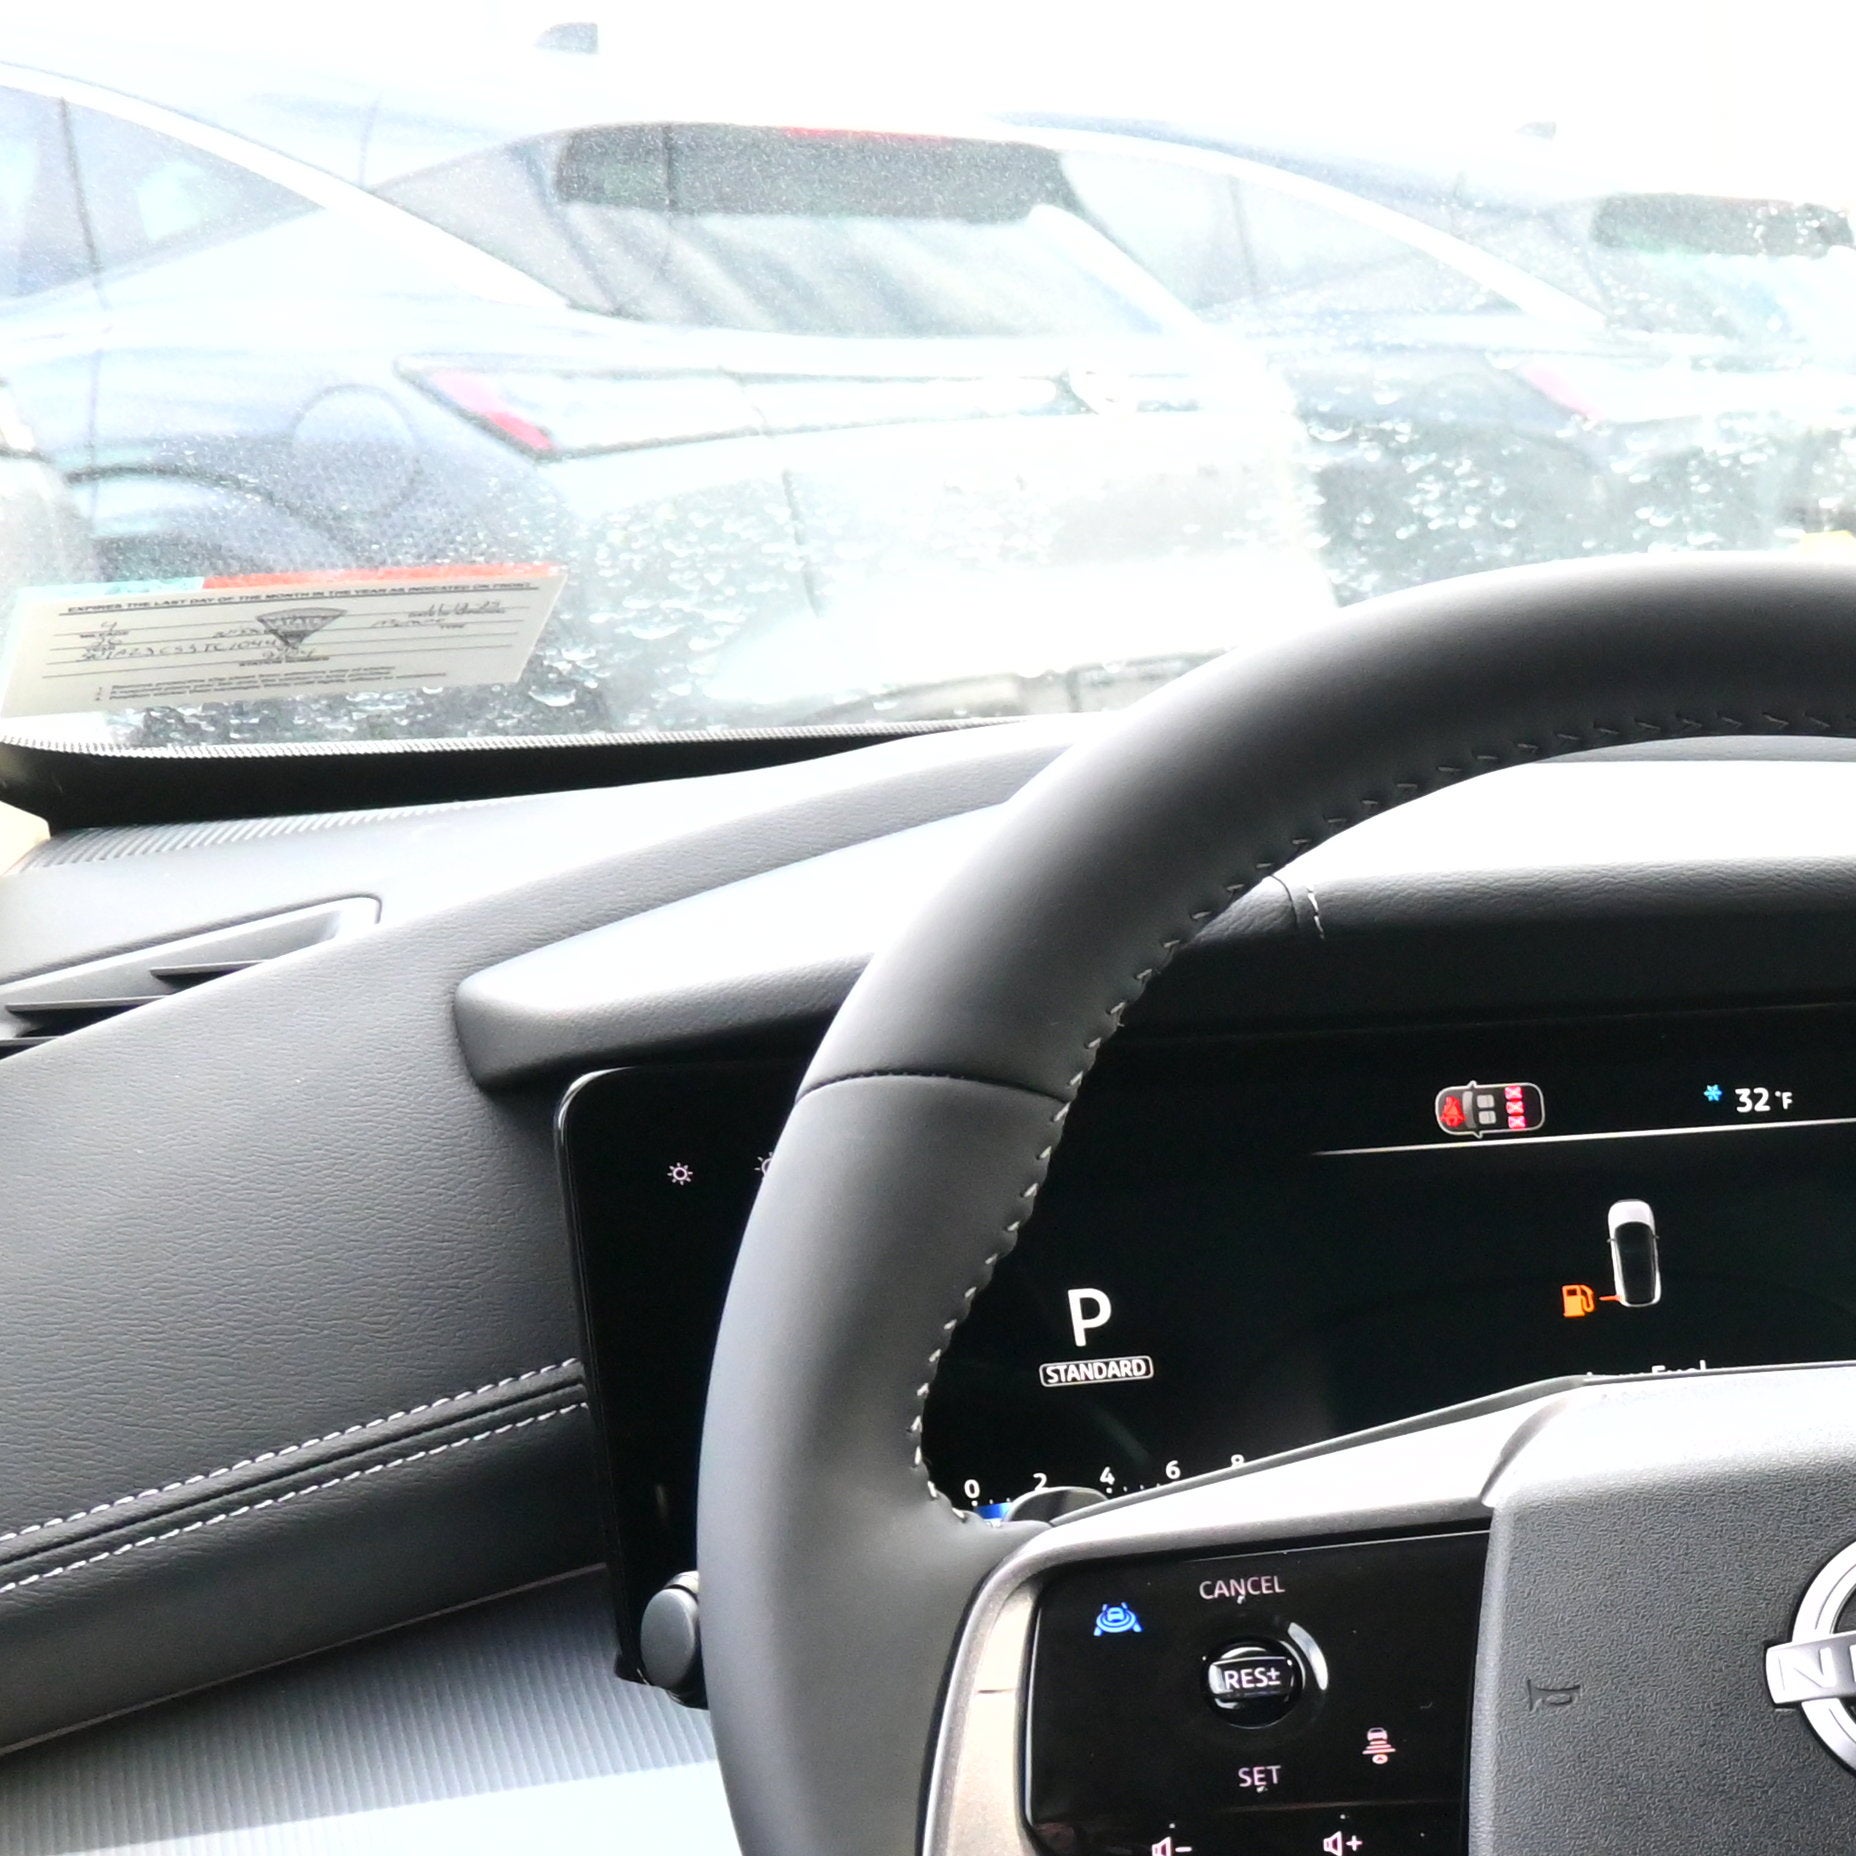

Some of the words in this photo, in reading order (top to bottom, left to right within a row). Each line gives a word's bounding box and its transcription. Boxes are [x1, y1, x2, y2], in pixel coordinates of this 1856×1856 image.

[1067, 1288, 1112, 1347] P
[1045, 1359, 1147, 1384] STANDARD
[1100, 1467, 1116, 1485] 4
[1166, 1461, 1182, 1480] 6
[1199, 1575, 1285, 1600] CANCEL
[1237, 1765, 1281, 1788] SET
